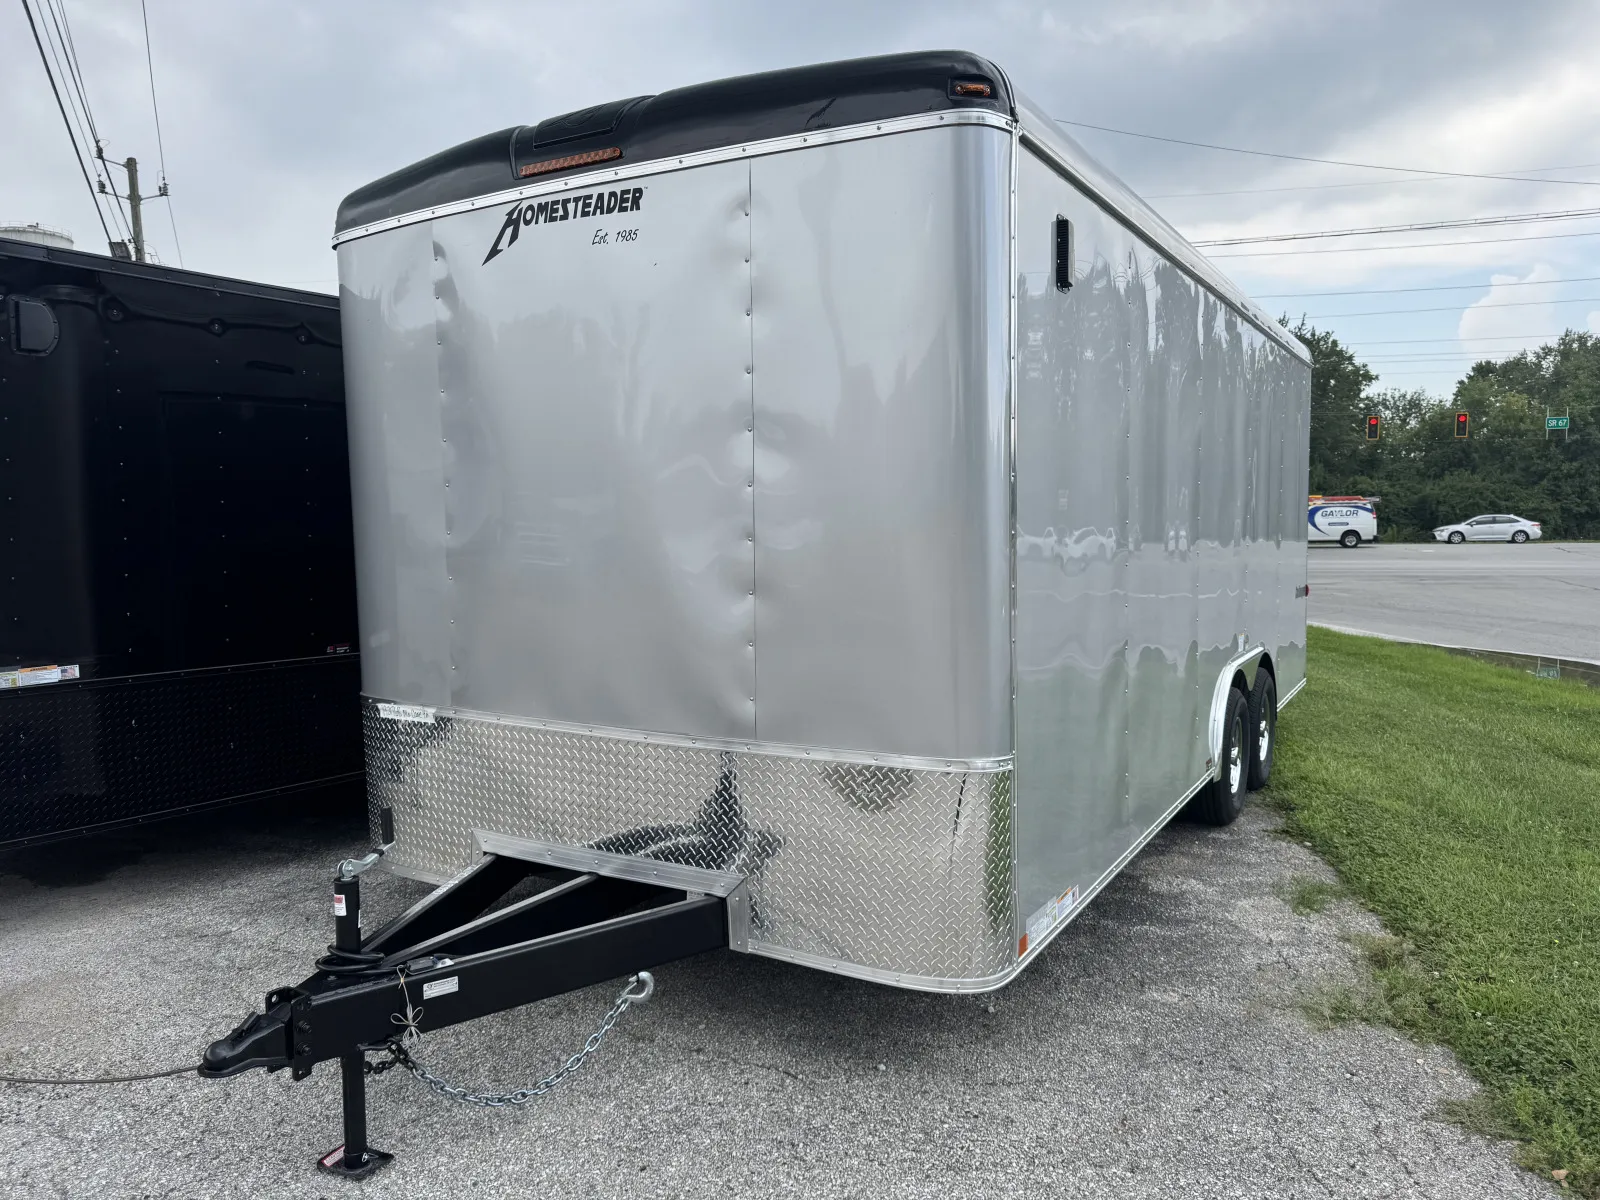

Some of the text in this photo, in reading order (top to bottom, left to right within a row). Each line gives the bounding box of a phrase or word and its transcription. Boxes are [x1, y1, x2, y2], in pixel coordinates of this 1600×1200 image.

[482, 187, 644, 266] HOMESTEADER
[592, 229, 640, 245] Est. 1985
[1548, 419, 1567, 427] SR 67
[1321, 509, 1360, 518] GAYLOR
